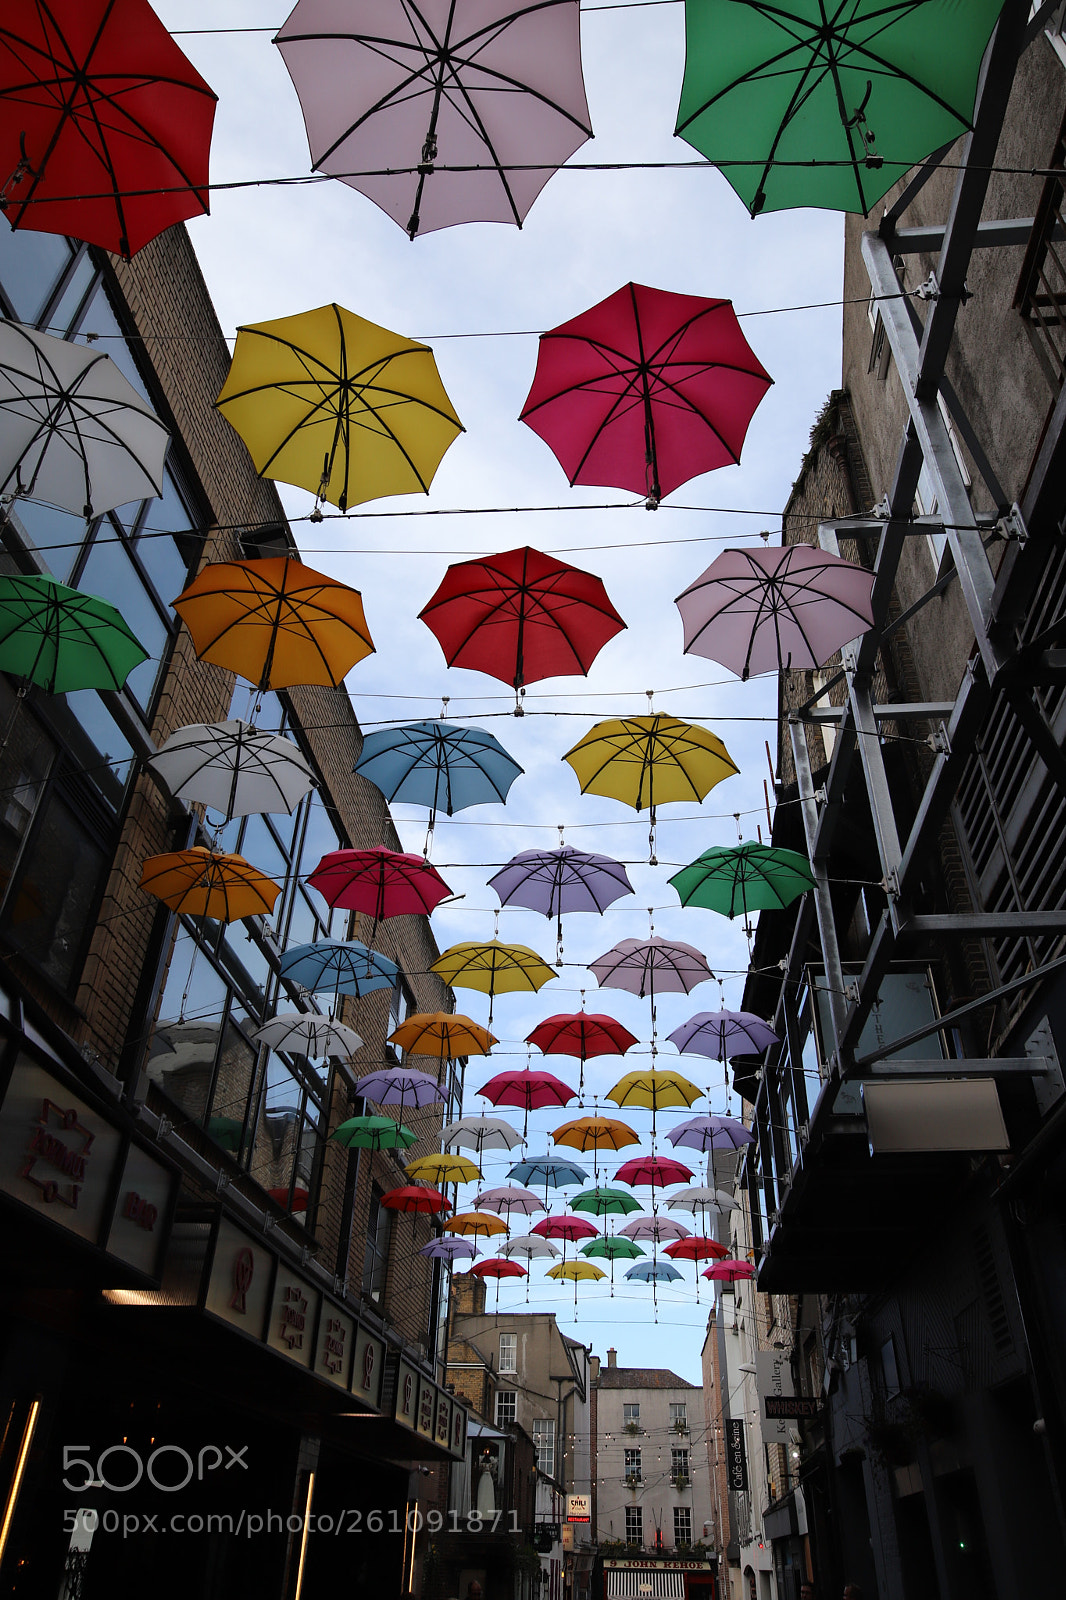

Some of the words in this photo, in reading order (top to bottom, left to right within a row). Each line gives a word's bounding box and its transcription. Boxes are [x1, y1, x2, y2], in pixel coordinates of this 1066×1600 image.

[772, 1358, 783, 1397] Gallery
[767, 1401, 816, 1415] WHISKEY
[734, 1451, 742, 1464] en
[732, 1465, 743, 1488] Café
[610, 1560, 617, 1568] 9
[624, 1560, 657, 1568] JOHN
[664, 1561, 704, 1569] KEHOE
